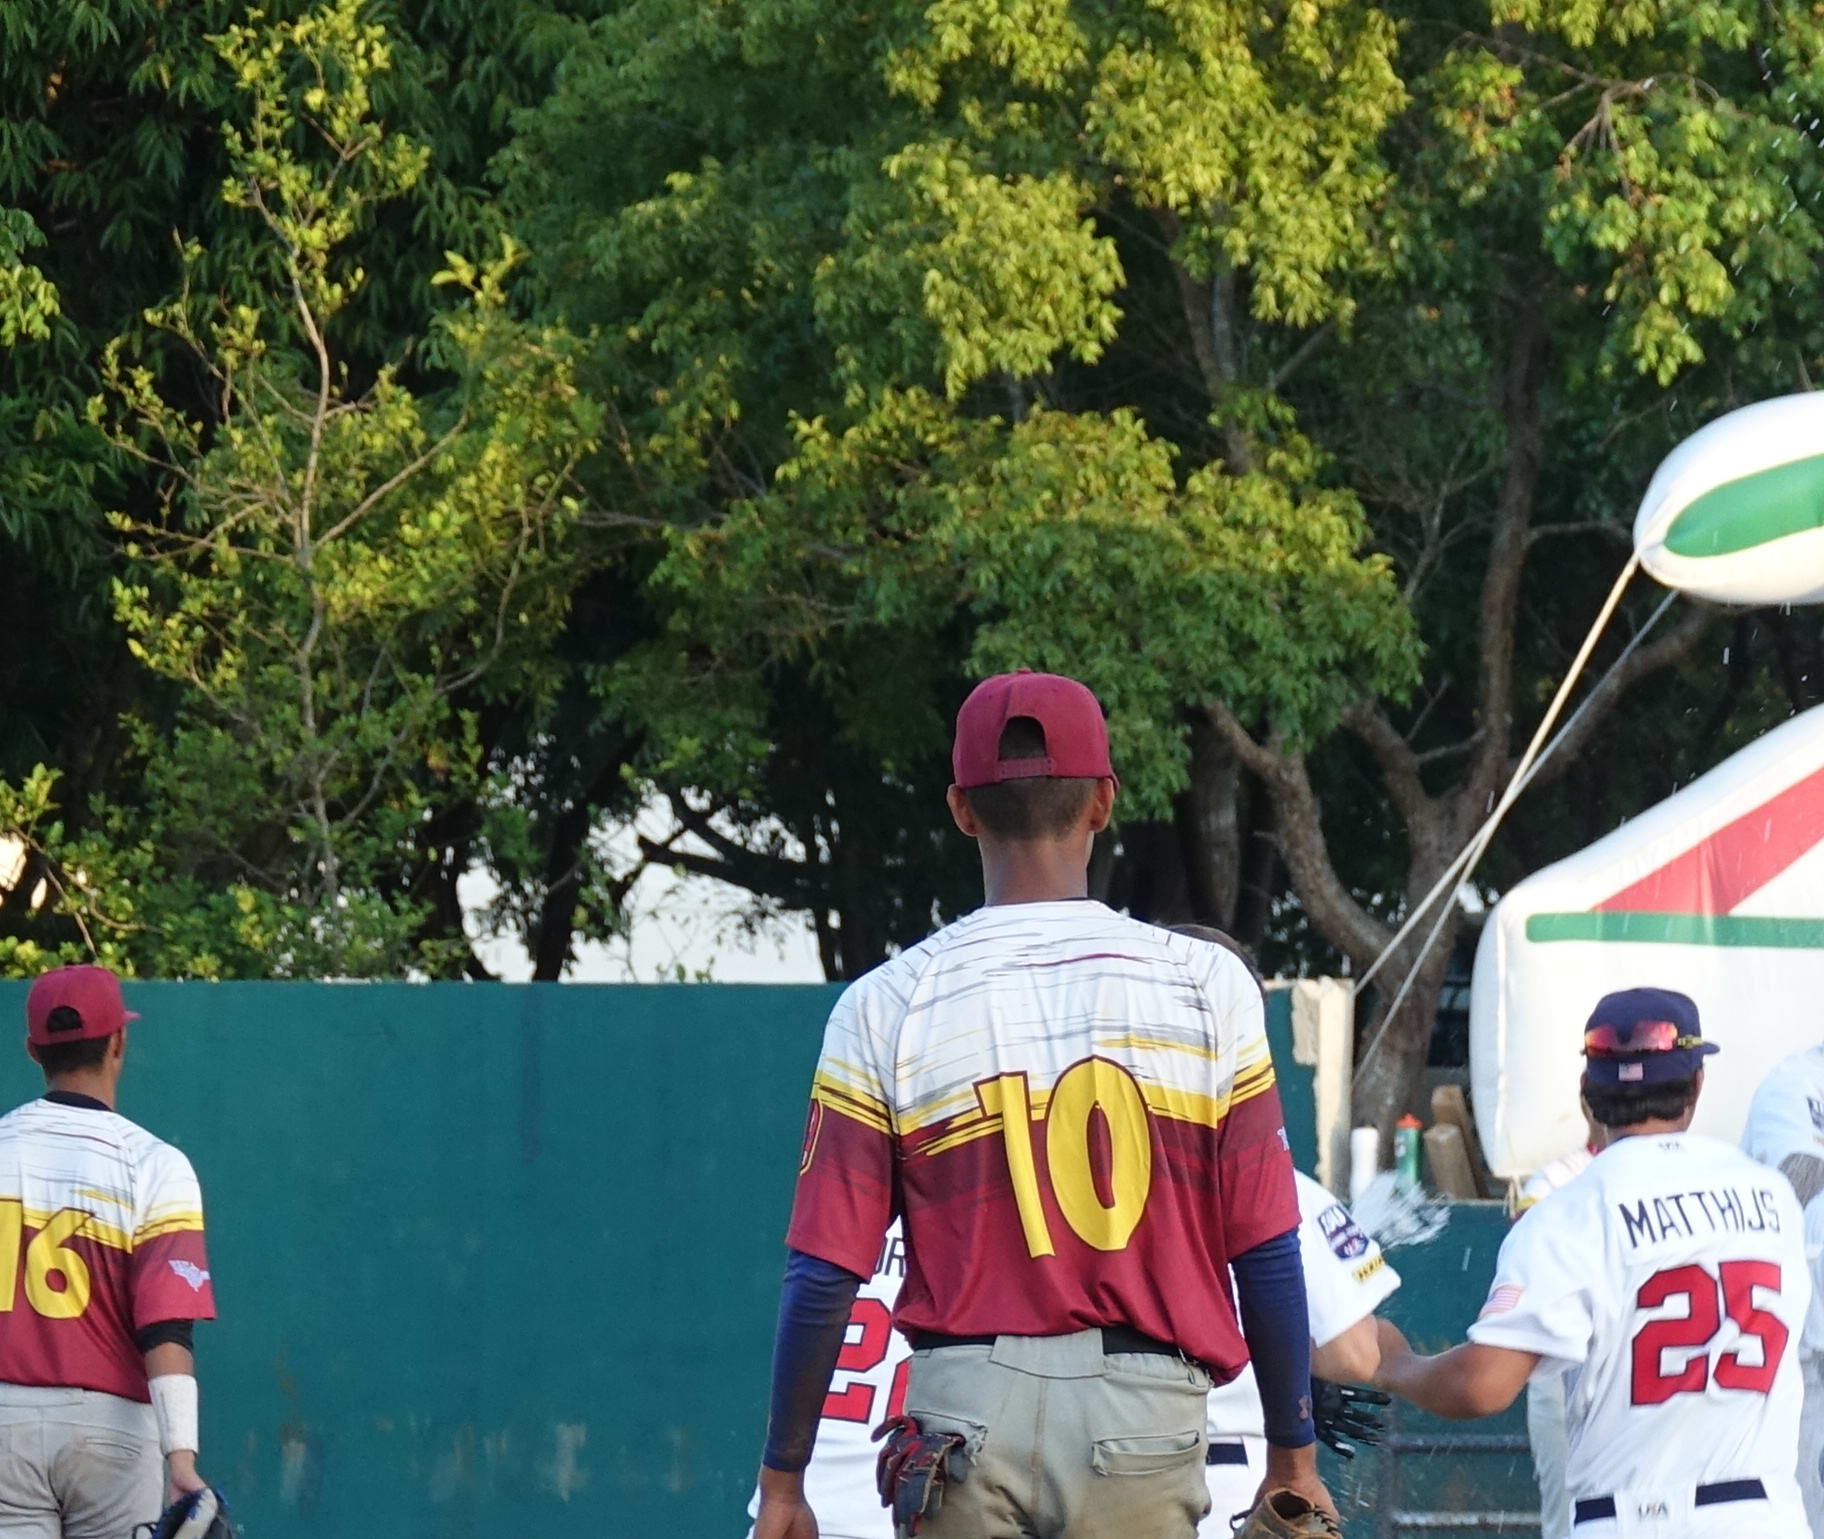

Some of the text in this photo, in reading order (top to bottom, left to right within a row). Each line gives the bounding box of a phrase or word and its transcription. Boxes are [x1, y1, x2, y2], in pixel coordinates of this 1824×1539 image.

[972, 1054, 1151, 1259] 10
[1618, 1186, 1781, 1249] MATTHIJS
[0, 1197, 91, 1319] 16
[1630, 1259, 1789, 1407] 25
